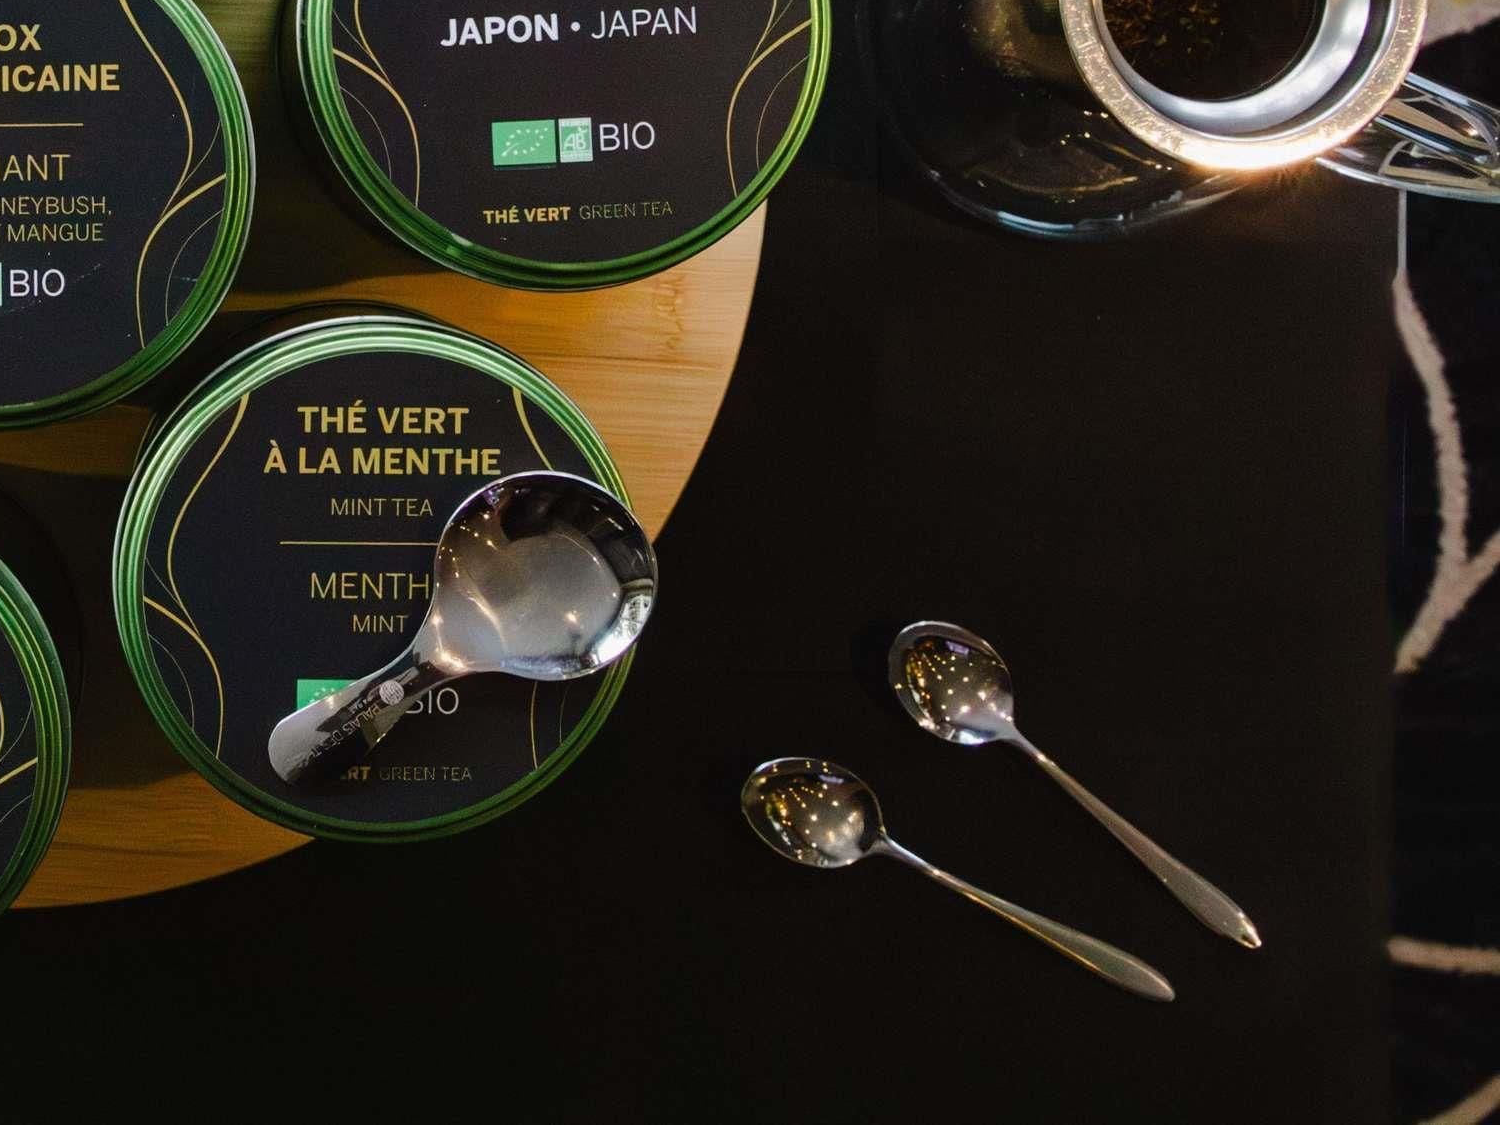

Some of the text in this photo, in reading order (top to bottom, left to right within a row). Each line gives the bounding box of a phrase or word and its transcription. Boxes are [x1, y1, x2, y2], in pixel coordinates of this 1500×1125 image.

[441, 7, 696, 46] JAPON JAPAN
[599, 122, 655, 151] BIO
[483, 201, 672, 224] THÉ VERT GREEN TEA
[8, 223, 103, 241] MANGUE
[10, 269, 65, 296] BIO
[298, 400, 469, 434] THÉ VERT
[264, 439, 501, 475] À LA MENTHE
[331, 498, 433, 516] MINT TEA
[311, 572, 428, 599] MENTH
[353, 614, 407, 632] MINT
[341, 766, 472, 781] RT GREEN TEA
